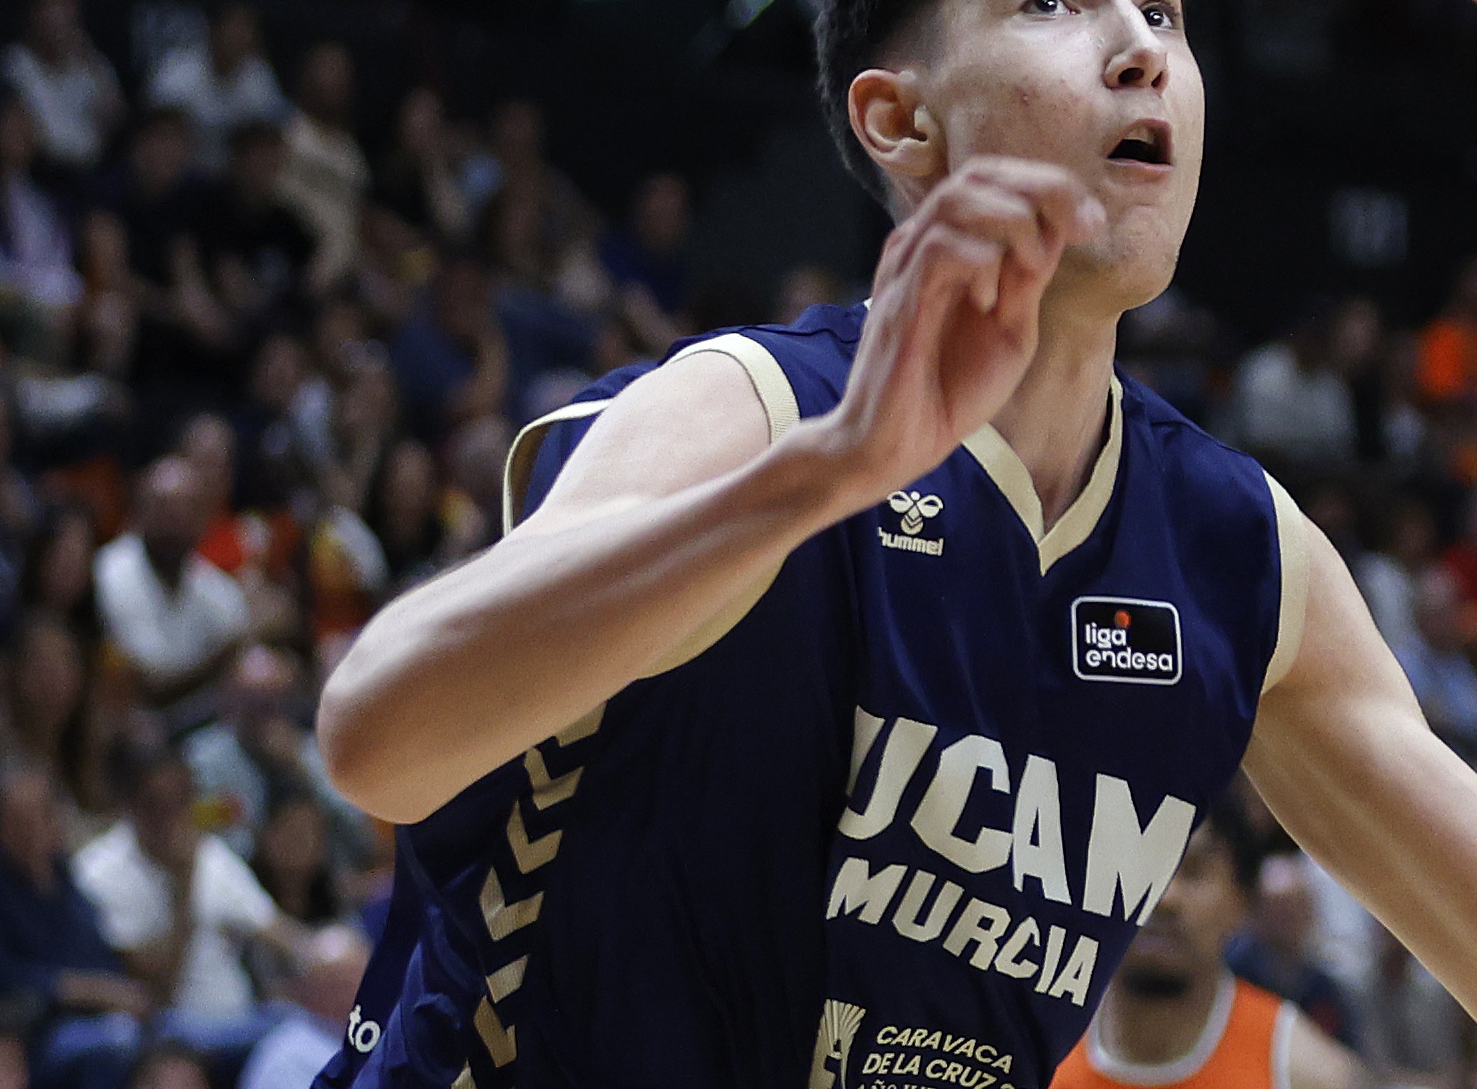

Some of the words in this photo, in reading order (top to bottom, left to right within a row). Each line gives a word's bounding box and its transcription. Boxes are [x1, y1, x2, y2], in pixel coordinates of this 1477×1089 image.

[1084, 621, 1128, 649] liga
[1085, 646, 1174, 672] endesa
[837, 704, 1197, 927] UCAM
[825, 856, 1100, 1008] MURCIA
[861, 1052, 896, 1075] DE
[891, 1052, 922, 1076] LA
[924, 1058, 998, 1089] CRUZ
[875, 1025, 1014, 1075] CARAVACA
